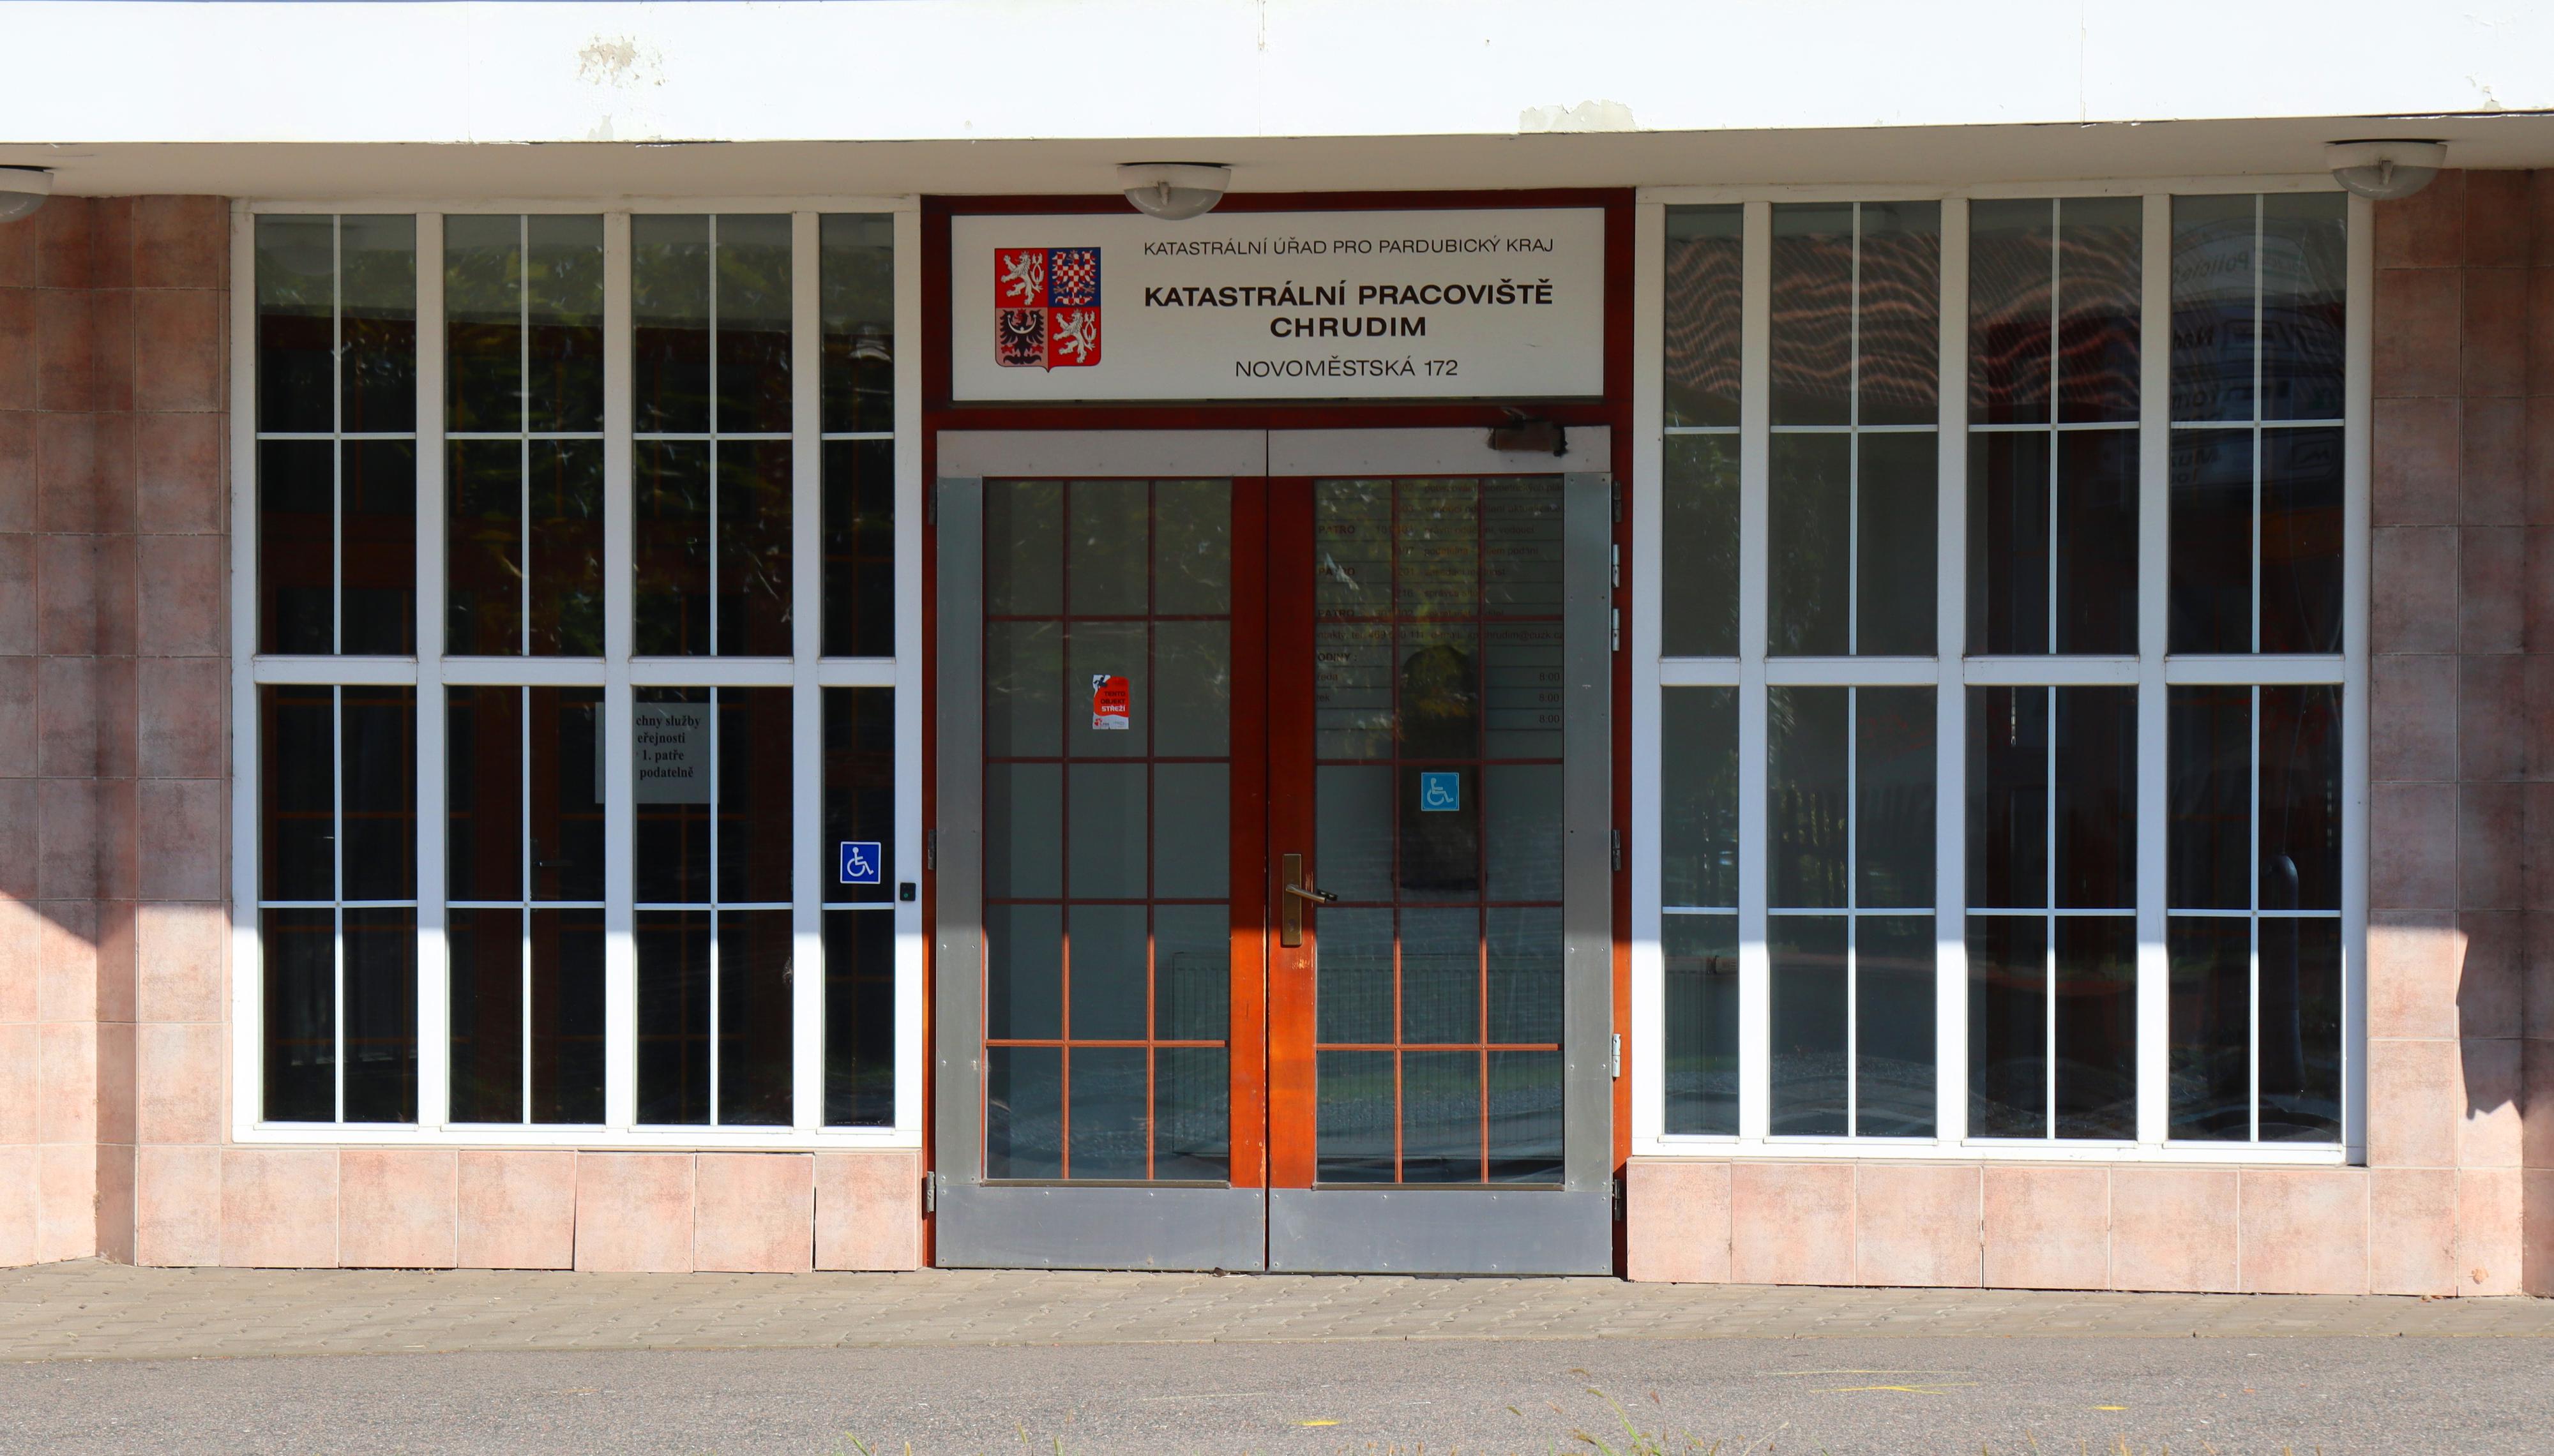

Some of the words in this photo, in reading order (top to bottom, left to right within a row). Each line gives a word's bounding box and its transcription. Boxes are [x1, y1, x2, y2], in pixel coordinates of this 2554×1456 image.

[1144, 237, 1267, 255] KATASTRÁLNÍ
[1274, 237, 1327, 254] ÚŘAD
[1333, 240, 1372, 254] PRO
[1379, 235, 1500, 253] PARDUBICKÝ
[1507, 239, 1553, 252] KRAJ
[1145, 280, 1347, 307] KATASTRÁLNÍ
[1359, 278, 1553, 305] PRACOVIŠTĚ
[1270, 317, 1426, 338] CHRUDIM
[1235, 356, 1416, 378] NOVOMĚSTSKÁ
[1424, 360, 1458, 376] 172
[1319, 567, 1355, 576] PARO
[636, 715, 661, 729] chny
[665, 715, 701, 729] služby
[637, 732, 685, 746] eřejnosti
[643, 749, 651, 761] 1.
[655, 749, 684, 763] patře
[640, 766, 694, 781] podatelně
